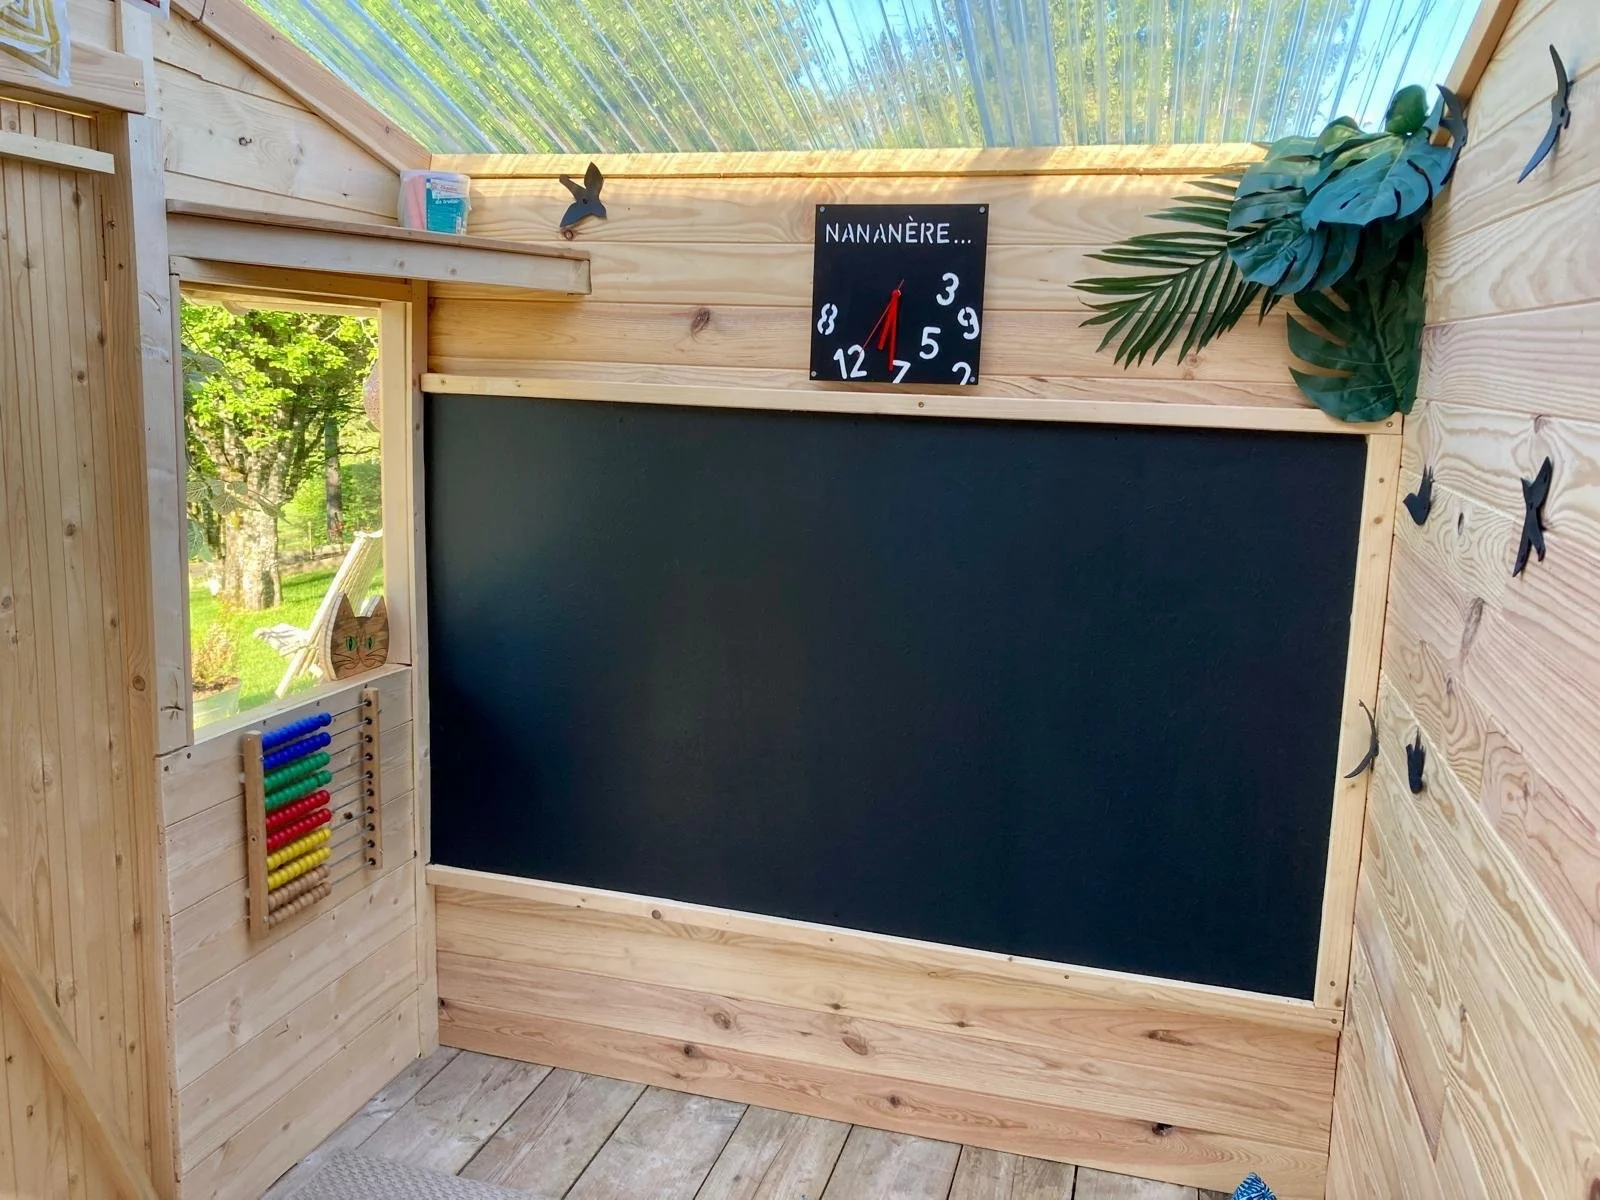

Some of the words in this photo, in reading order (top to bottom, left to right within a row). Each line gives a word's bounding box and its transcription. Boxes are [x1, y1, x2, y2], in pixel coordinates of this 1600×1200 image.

[825, 215, 972, 244] NANANÈRE...
[936, 272, 960, 306] 3
[816, 303, 839, 335] 8
[957, 306, 980, 340] 9
[919, 326, 942, 360] 5
[833, 344, 868, 380] 12
[892, 359, 912, 384] 7
